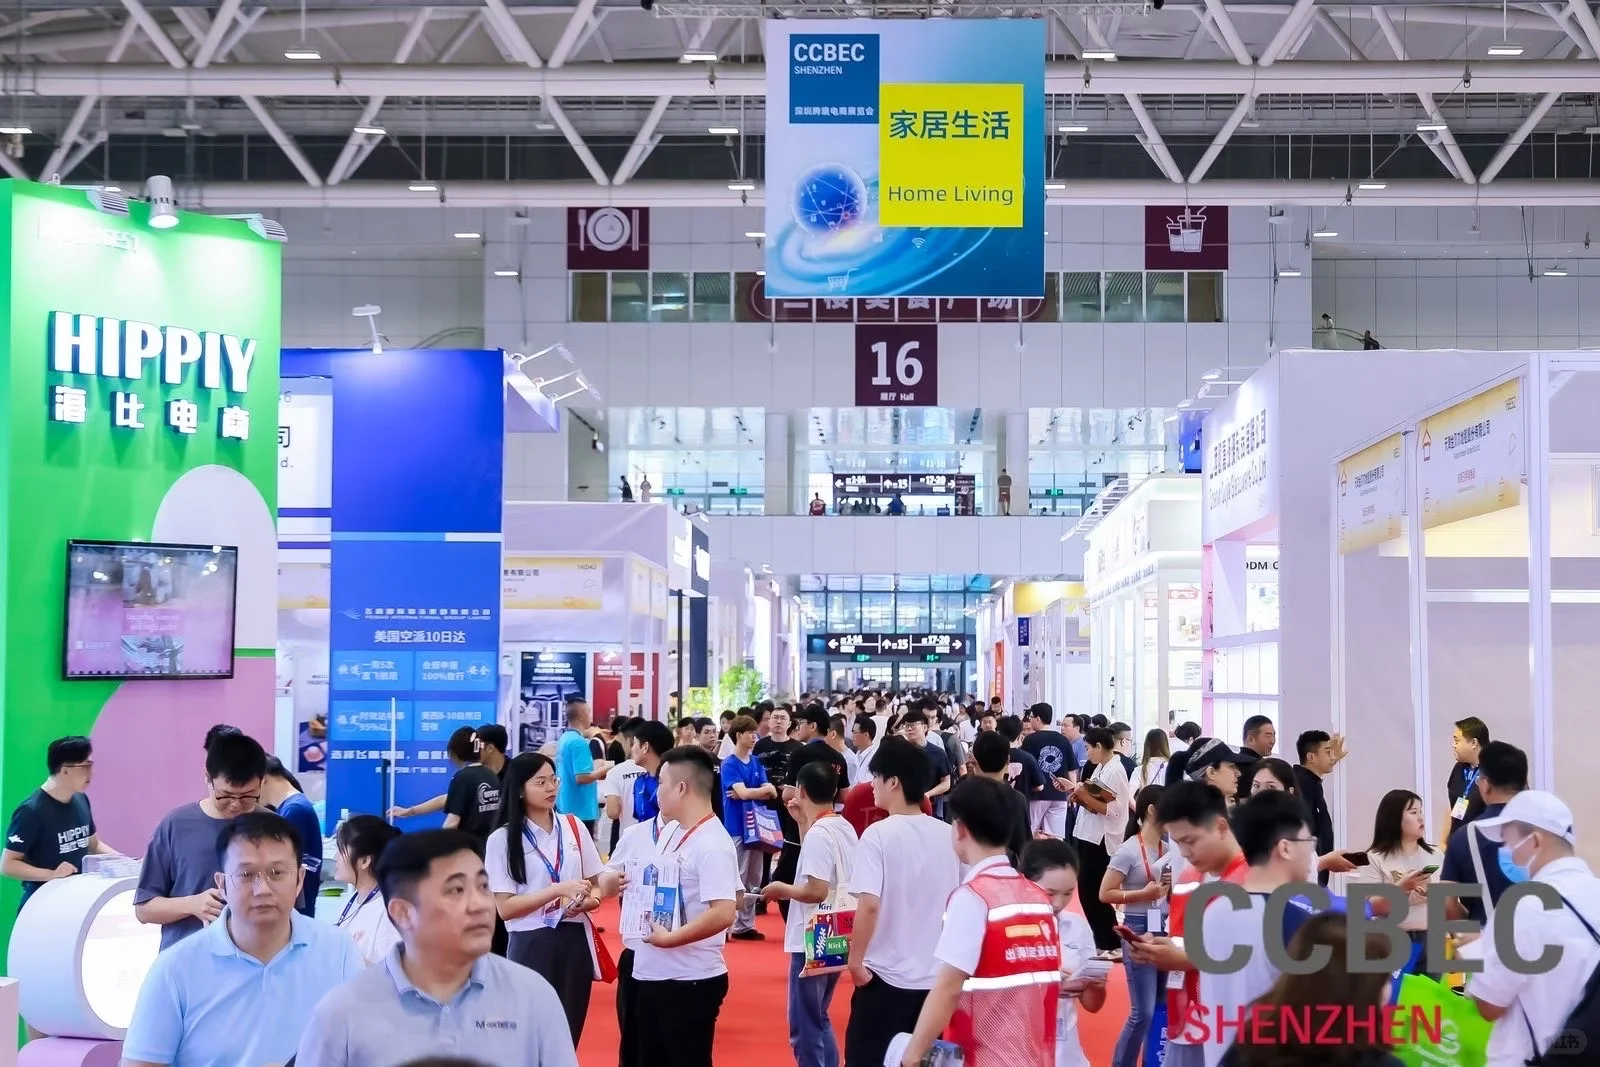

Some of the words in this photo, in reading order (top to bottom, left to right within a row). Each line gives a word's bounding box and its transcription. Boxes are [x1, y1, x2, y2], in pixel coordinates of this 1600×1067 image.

[794, 43, 865, 62] CCBEC
[794, 65, 843, 75] SHENZHEN
[889, 110, 1011, 140] 家居生活
[888, 186, 947, 202] Home
[954, 186, 1013, 206] Living
[51, 311, 257, 393] HIPPIY
[871, 341, 923, 386] 16
[374, 630, 466, 643] 美国空派10日达
[818, 902, 833, 910] Kiri
